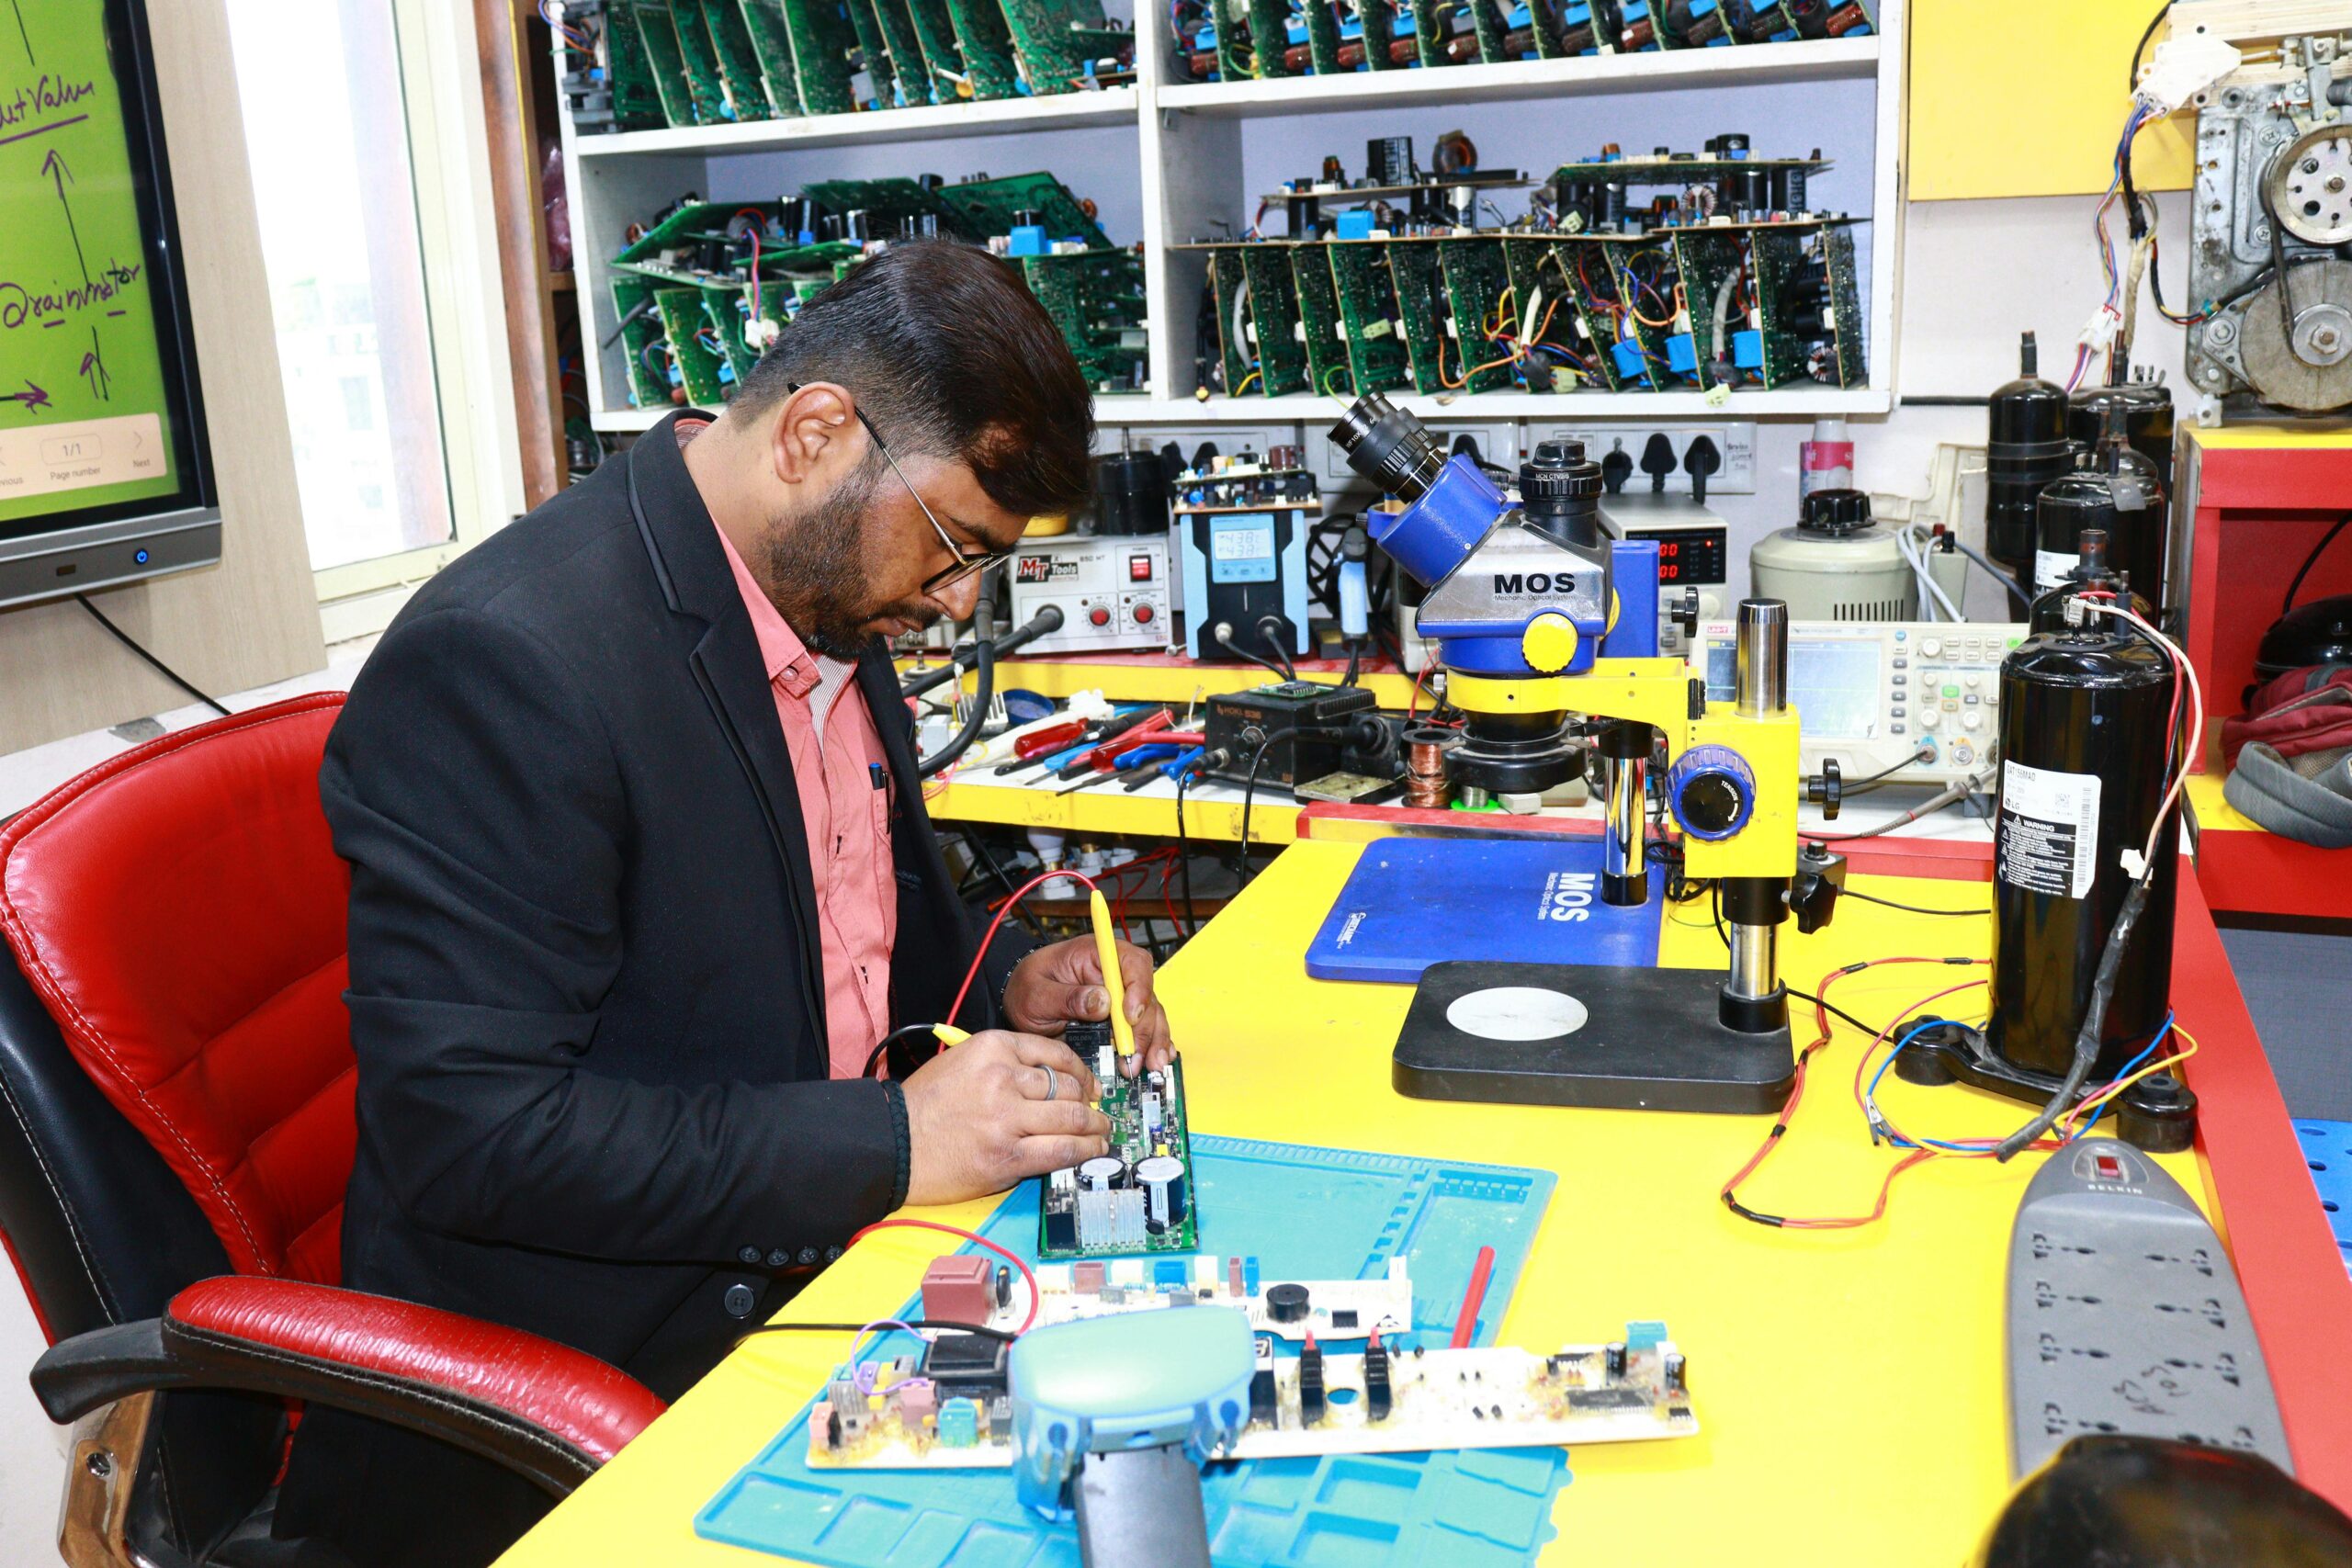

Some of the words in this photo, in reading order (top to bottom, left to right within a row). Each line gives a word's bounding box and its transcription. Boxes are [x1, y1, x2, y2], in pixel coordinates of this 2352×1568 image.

[62, 443, 82, 457] 1/1
[132, 458, 151, 468] Next
[50, 470, 71, 481] Page
[72, 467, 102, 479] number
[0, 477, 24, 487] vious
[1050, 562, 1079, 576] Tools
[1494, 572, 1576, 593] MOS
[1721, 780, 1738, 801] TENSION
[2023, 818, 2055, 832] WARNING
[1550, 873, 1596, 922] MOS
[2087, 1184, 2143, 1195] BELKIN
